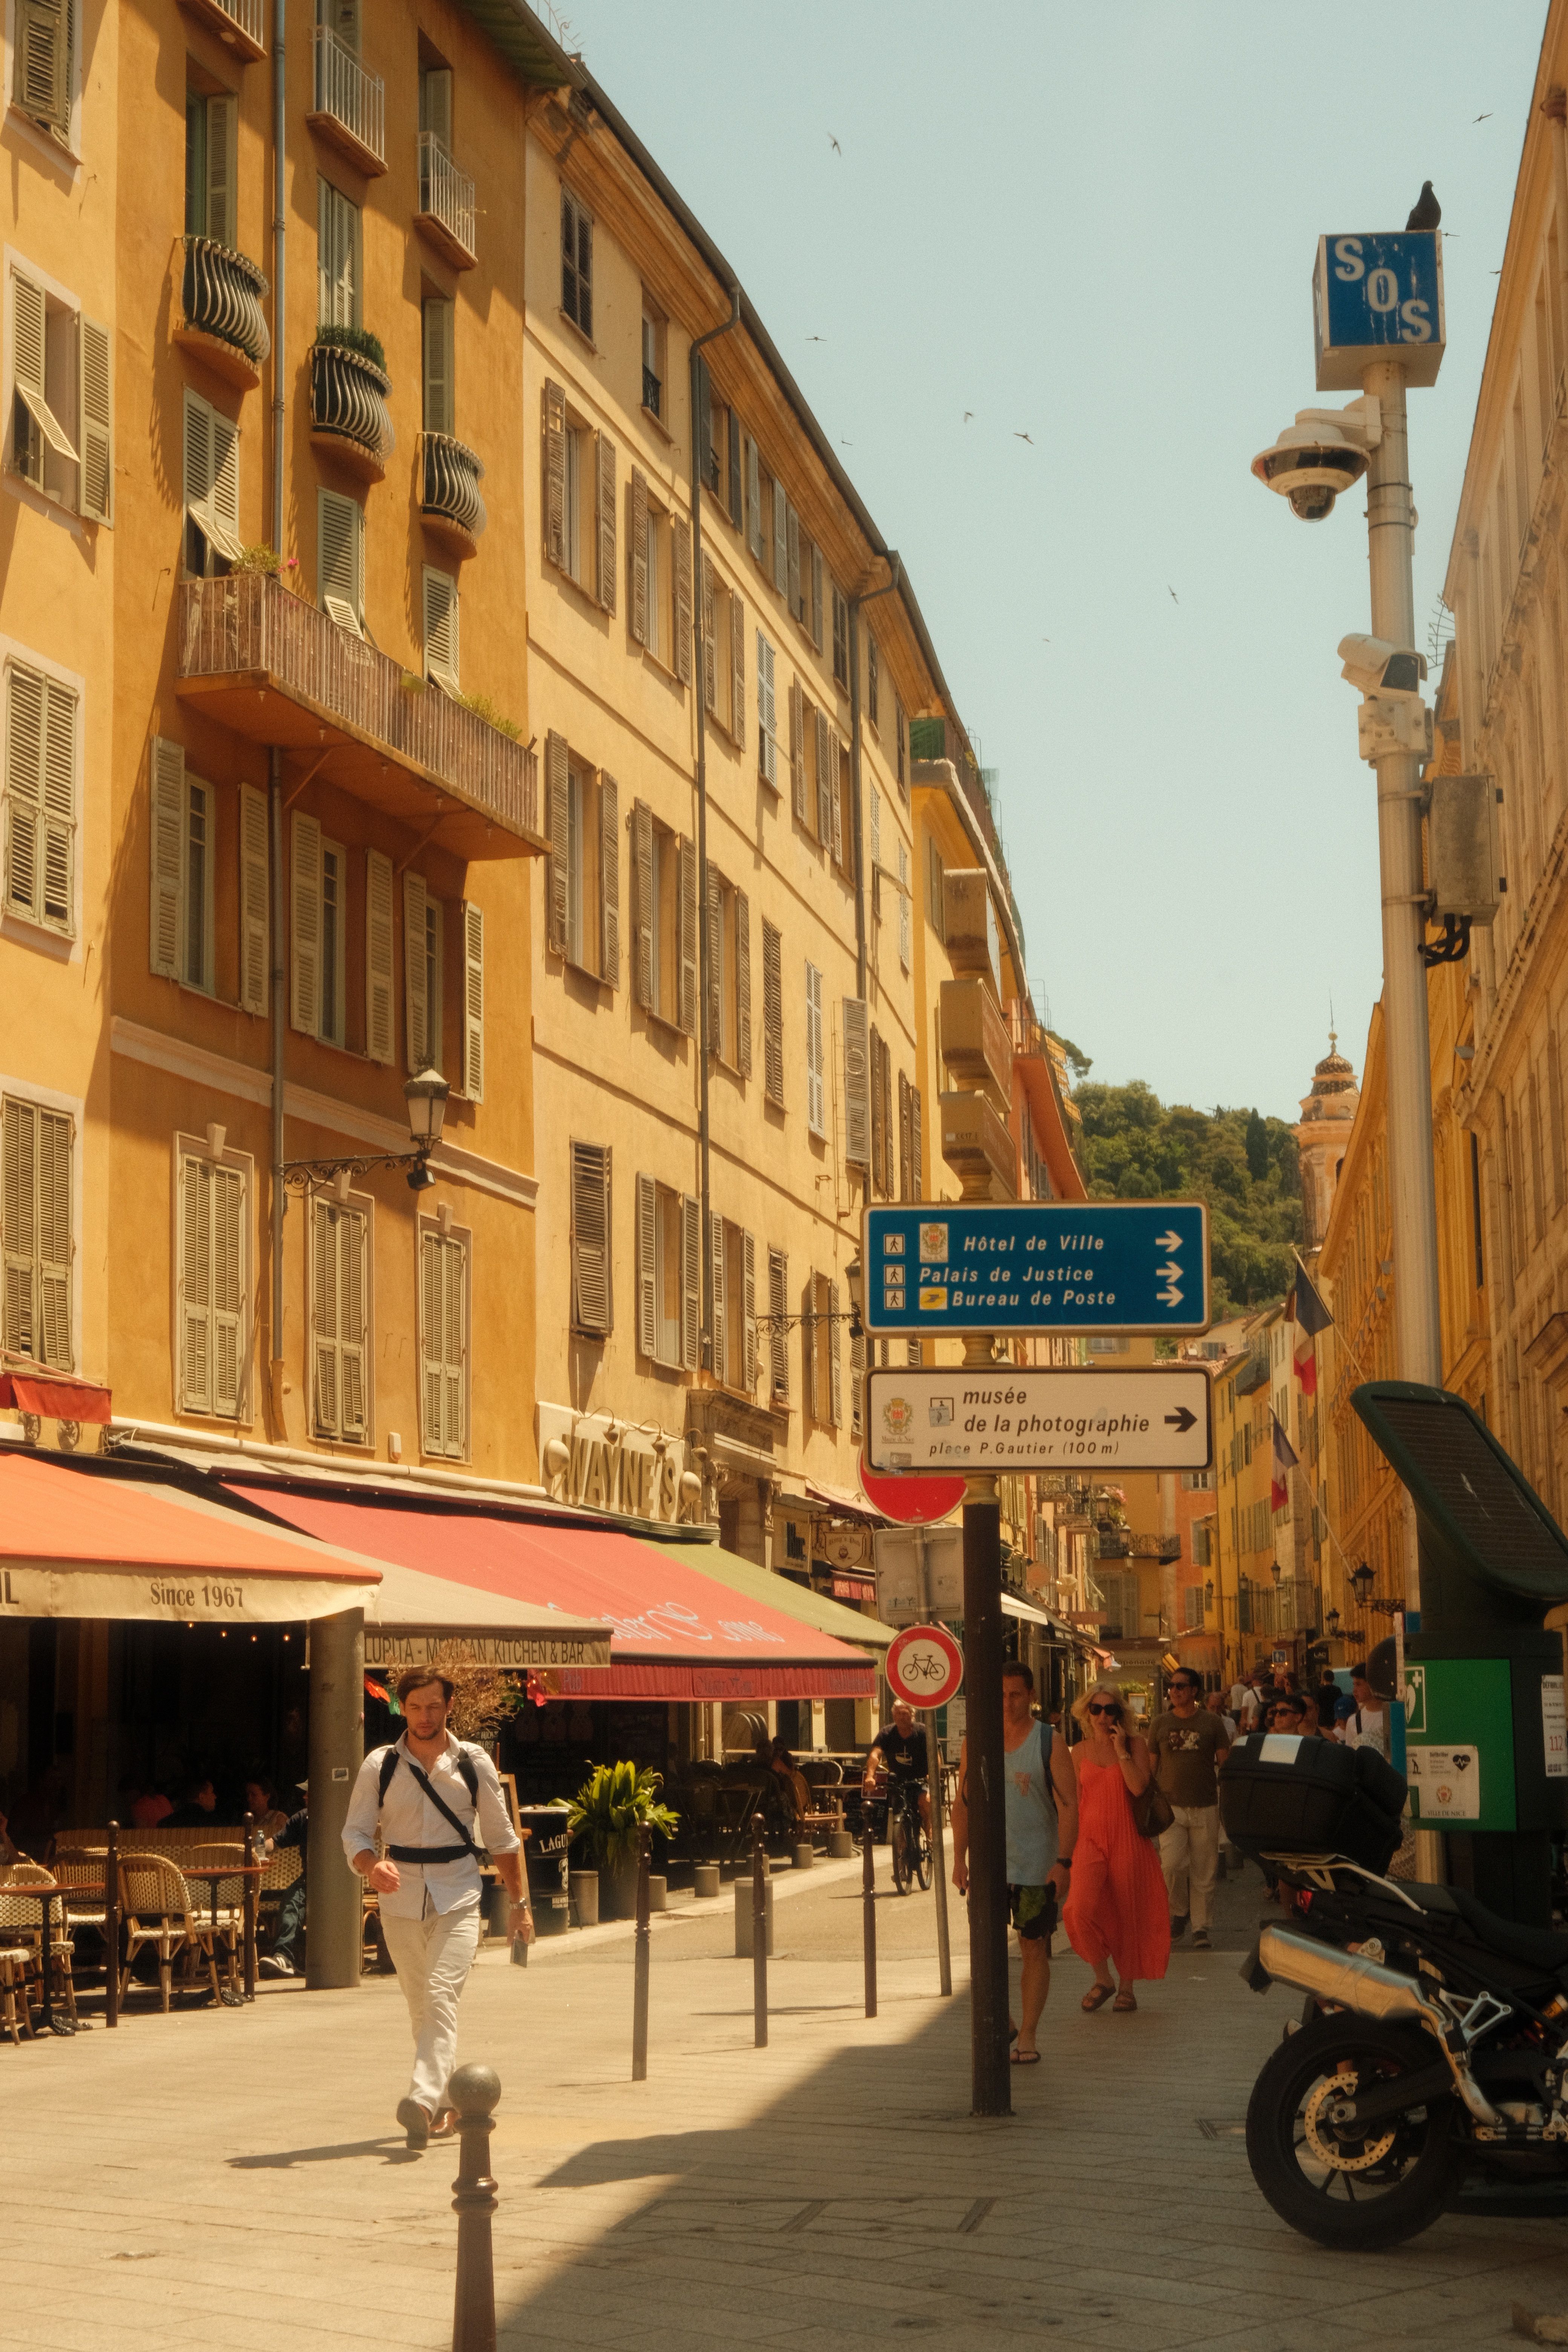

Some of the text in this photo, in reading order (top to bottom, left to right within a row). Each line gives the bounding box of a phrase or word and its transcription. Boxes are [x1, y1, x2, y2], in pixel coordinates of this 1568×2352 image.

[1335, 237, 1432, 343] SOS
[964, 1234, 1104, 1252] Hôtel de Ville
[919, 1266, 1093, 1282] Palais de Justice
[952, 1289, 1115, 1306] Bureau de Poste
[963, 1386, 1027, 1404] musée
[964, 1414, 1150, 1437] de la photographie
[929, 1441, 1119, 1457] place P.Gautier (100 m)
[562, 1433, 676, 1524] WAYNE'S
[151, 1583, 243, 1608] Since 1967
[364, 1637, 414, 1663] LUPITA
[494, 1639, 547, 1664] KITCHEN
[550, 1640, 558, 1664] &
[561, 1640, 584, 1664] BAR
[1549, 1735, 1563, 1751] 112
